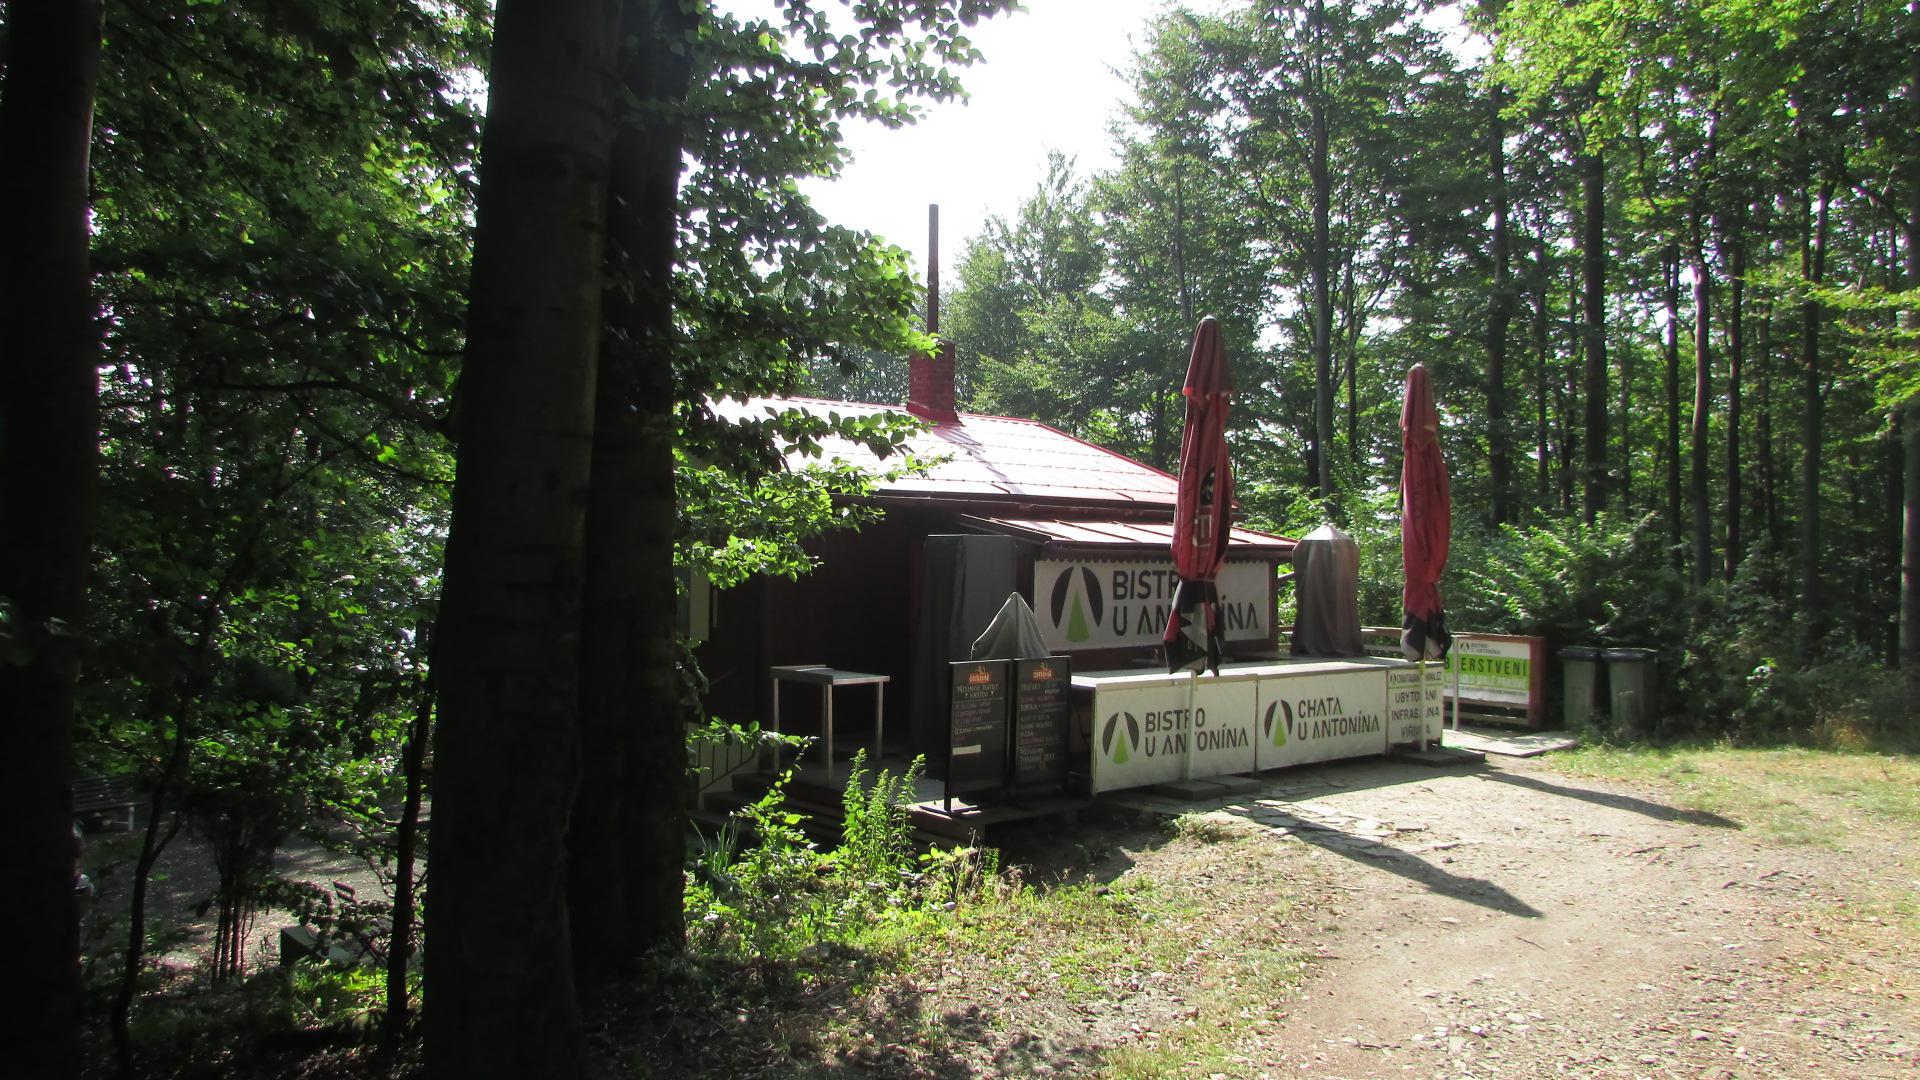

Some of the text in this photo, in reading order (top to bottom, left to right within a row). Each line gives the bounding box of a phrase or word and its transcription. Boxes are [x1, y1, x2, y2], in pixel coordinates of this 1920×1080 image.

[1112, 570, 1180, 601] BISTR
[1113, 595, 1259, 637] U ANÍNA
[1443, 657, 1528, 676] BERSTVENÍ
[1297, 697, 1343, 719] CHATA
[1145, 723, 1249, 757] U ANONÍNA
[1297, 710, 1380, 741] U ANTONÍNA
